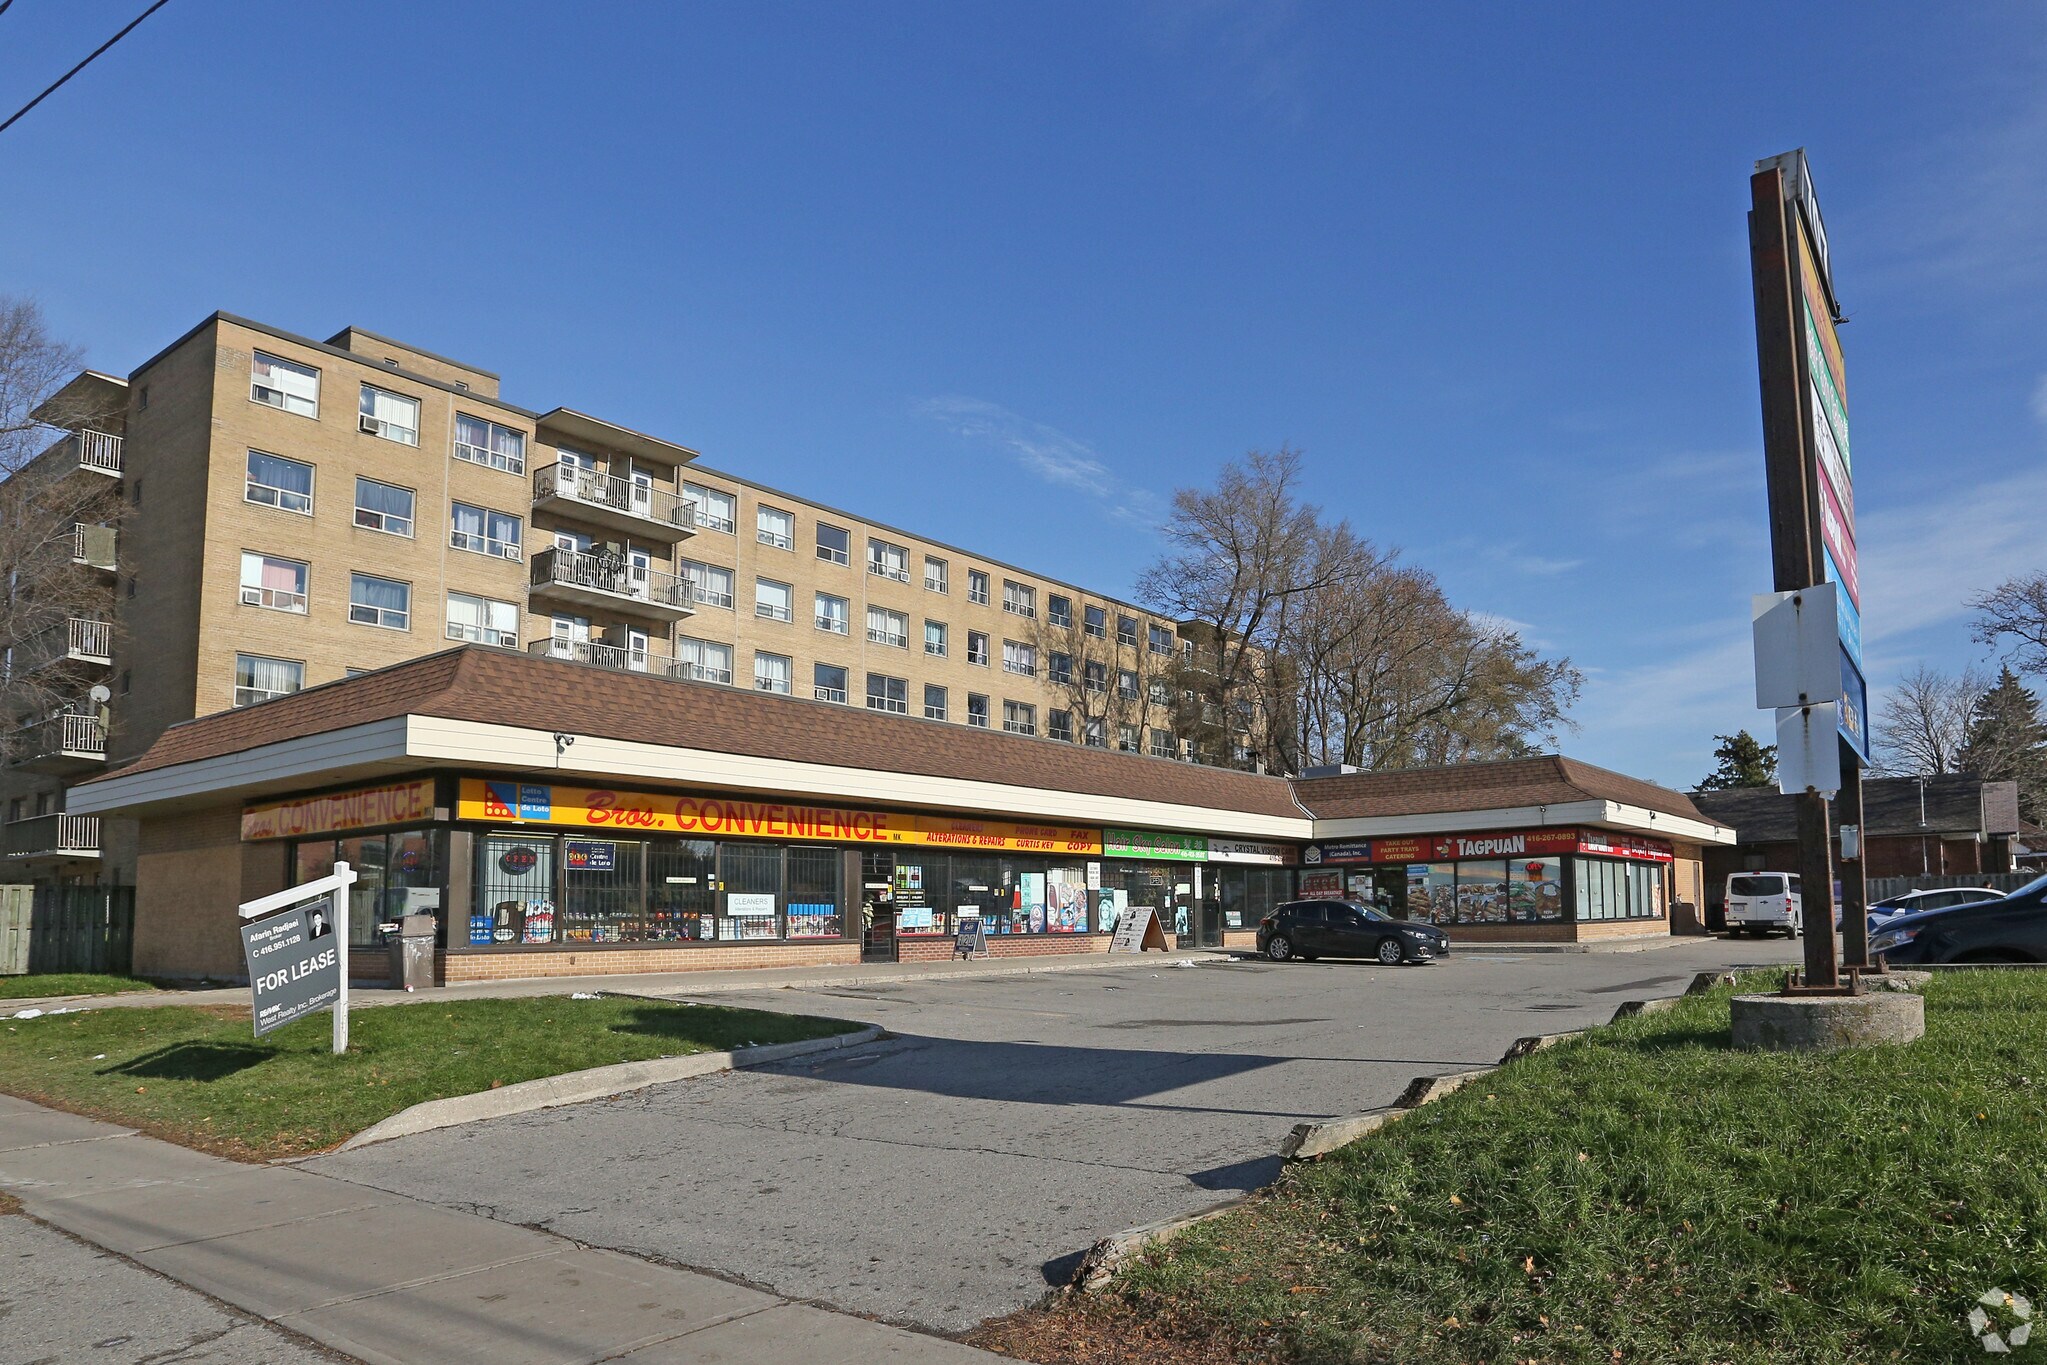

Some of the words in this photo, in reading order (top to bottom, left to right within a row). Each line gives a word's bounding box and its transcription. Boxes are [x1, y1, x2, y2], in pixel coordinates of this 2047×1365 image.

[522, 786, 542, 795] Lotto
[521, 796, 547, 804] Centre
[279, 783, 422, 834] CONVENIENCE
[532, 804, 550, 812] Loto
[585, 790, 664, 827] Bros.
[675, 798, 887, 840] CONVENIENCE
[1016, 826, 1038, 835] PHONE
[1040, 827, 1058, 836] CARD
[1070, 830, 1089, 839] FAX
[927, 832, 971, 845] ALTERATIONS
[979, 837, 1006, 847] REPAIRS
[1016, 839, 1040, 848] CURTIS
[1041, 840, 1055, 849] KEY
[1107, 832, 1130, 851] Hair
[1132, 834, 1152, 856] Sky
[1154, 836, 1180, 855] Salon
[1456, 835, 1525, 856] TAGPUAN
[1526, 833, 1576, 842] 416-267-0893
[1067, 842, 1093, 851] COPY
[1234, 844, 1260, 854] CRYSTAL
[734, 898, 768, 906] CLEANERS
[250, 929, 273, 943] Afarin
[273, 918, 299, 935] Radjaei
[252, 949, 259, 958] C
[260, 934, 301, 955] 416.951.1128
[256, 968, 289, 995] FOR
[291, 948, 336, 981] LEASE
[259, 1016, 277, 1026] West
[277, 1006, 297, 1020] Realty
[297, 1001, 308, 1010] Inc.
[309, 988, 337, 1004] Brokerage
